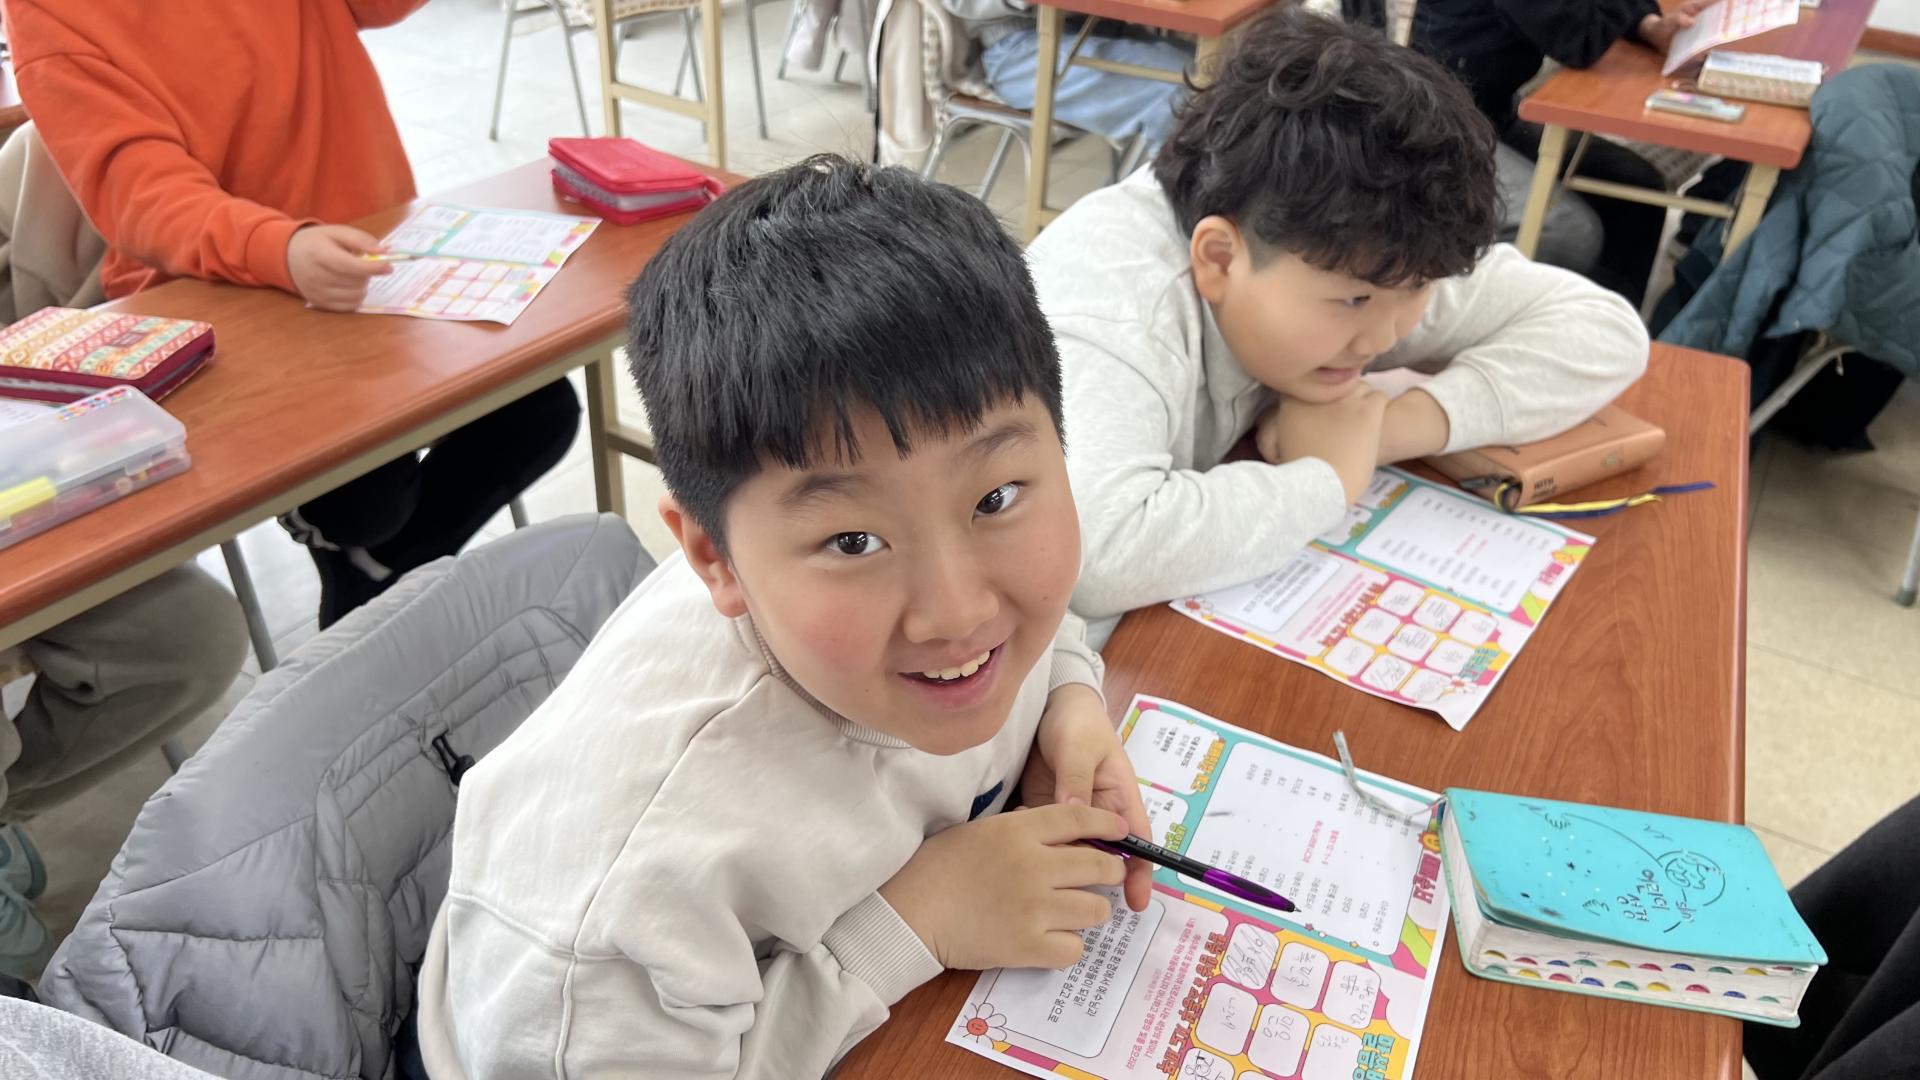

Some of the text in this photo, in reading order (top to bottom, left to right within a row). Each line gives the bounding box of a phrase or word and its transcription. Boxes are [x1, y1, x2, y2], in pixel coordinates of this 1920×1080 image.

[1106, 906, 1126, 936] 동행하는
[1124, 912, 1140, 934] 새학기
[1096, 934, 1113, 958] 초등부
[1113, 932, 1131, 956] 새로운
[1203, 931, 1227, 956] 말씀
[1081, 956, 1103, 989] 학생들이
[1099, 954, 1121, 986] 환경에서
[1058, 981, 1074, 1000] 삼고
[1073, 987, 1089, 1007] 되길!
[1085, 984, 1107, 1017] 예수님과
[1047, 997, 1066, 1024] 삶으로
[1159, 1006, 1171, 1020] 나는
[1177, 987, 1206, 1024] 초등부
[1155, 1048, 1180, 1075] 제목
